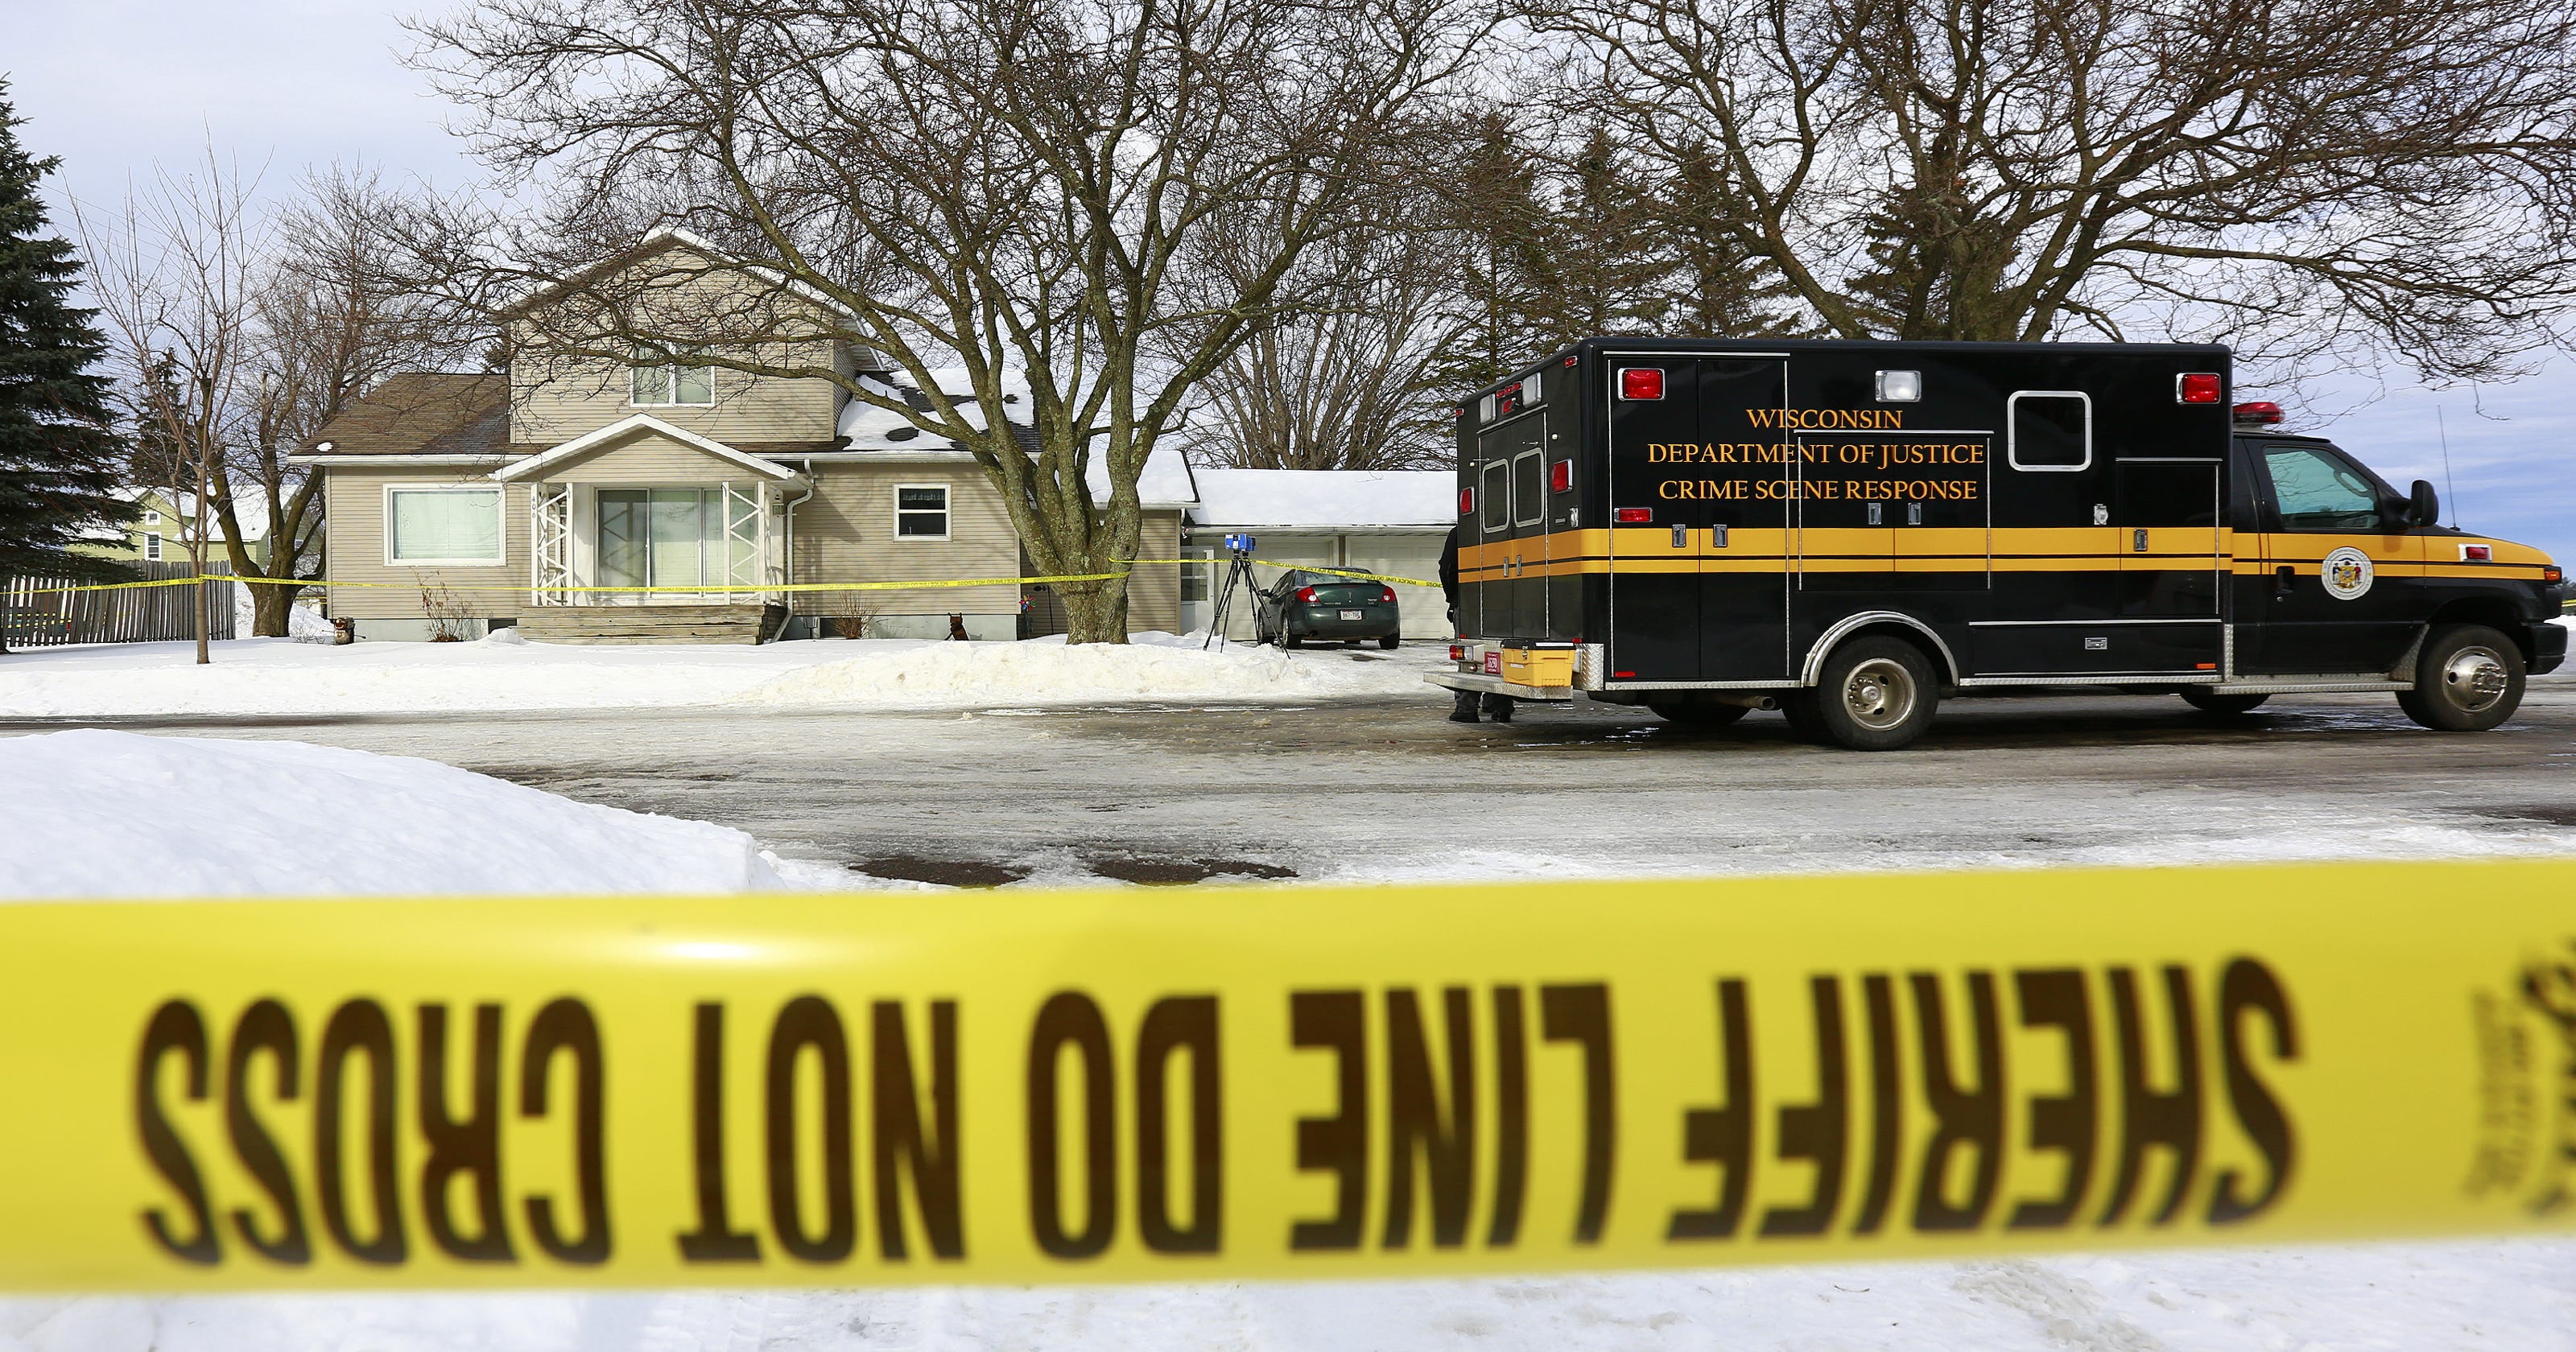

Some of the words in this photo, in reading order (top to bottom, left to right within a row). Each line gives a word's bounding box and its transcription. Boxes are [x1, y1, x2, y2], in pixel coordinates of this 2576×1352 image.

[1648, 443, 1834, 464] DEPARTMENT
[1839, 444, 1875, 464] OF
[1878, 444, 1984, 470] JUSTICE
[1659, 480, 1748, 500] CRIME
[1755, 480, 1839, 500] SCENE
[1845, 480, 1978, 500] RESPONSE
[1746, 409, 1903, 429] WISCONSIN
[133, 995, 614, 1268] CROSS
[675, 993, 968, 1267] NOT
[1025, 989, 1225, 1263] DO
[1286, 980, 1618, 1255] LINE
[1664, 954, 2304, 1244] SHERIFF
